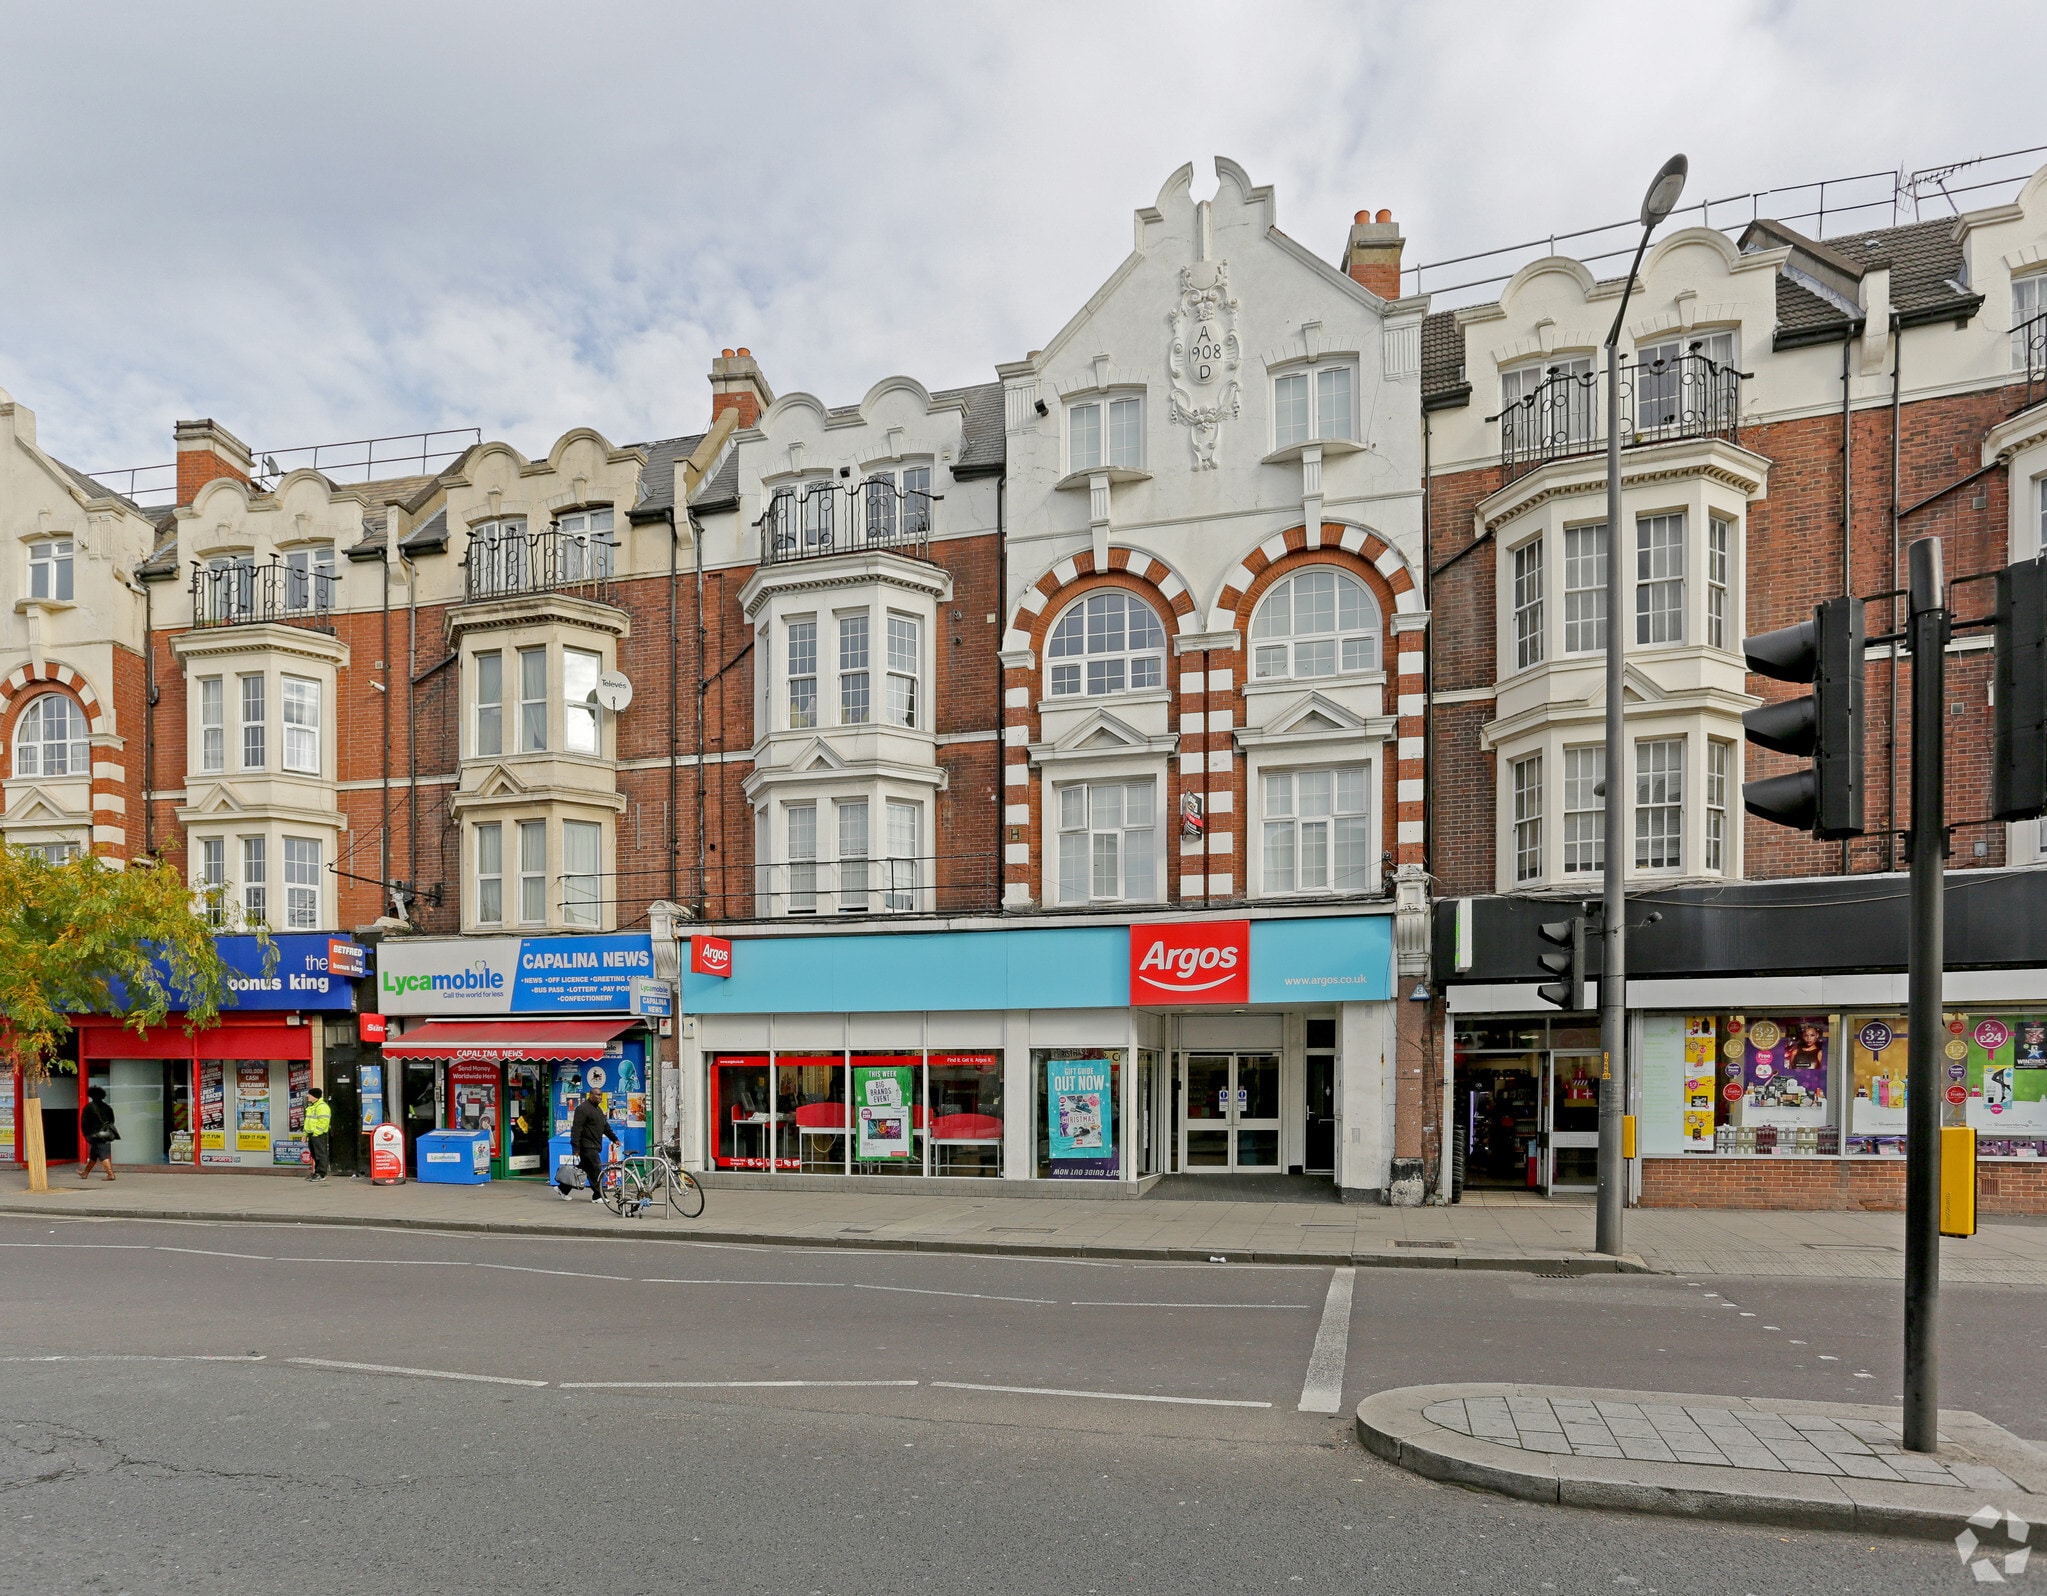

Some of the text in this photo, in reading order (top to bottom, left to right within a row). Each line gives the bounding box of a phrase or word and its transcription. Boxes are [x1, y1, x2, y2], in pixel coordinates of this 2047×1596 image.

[1197, 325, 1211, 344] A
[1188, 343, 1222, 363] 1908
[1199, 364, 1211, 379] D
[332, 944, 363, 957] BETFRED
[702, 943, 729, 963] Argos
[305, 954, 328, 971] the
[522, 950, 650, 969] CAPALINA NEWS
[1138, 940, 1238, 979] Argos
[332, 962, 363, 974] bonus king
[289, 973, 329, 993] king
[383, 967, 504, 996] Lycamobile
[592, 975, 625, 983] GREETING
[1284, 974, 1367, 988] www.argos.co.uk
[640, 983, 669, 994] Lycamobile
[642, 997, 668, 1006] CAPALINA
[647, 1005, 663, 1014] NEWS
[1984, 1023, 1991, 1031] 2
[1979, 1032, 2002, 1043] £24
[456, 1049, 524, 1057] CAPALINA NEWS
[868, 1070, 897, 1078] THIS WEEK
[1077, 1067, 1094, 1075] GUIDE
[875, 1081, 885, 1089] BIG
[1054, 1075, 1105, 1091] OUT NOW
[869, 1087, 892, 1097] BRANDS
[873, 1095, 890, 1103] EVENT
[1084, 1168, 1105, 1176] GUIDE
